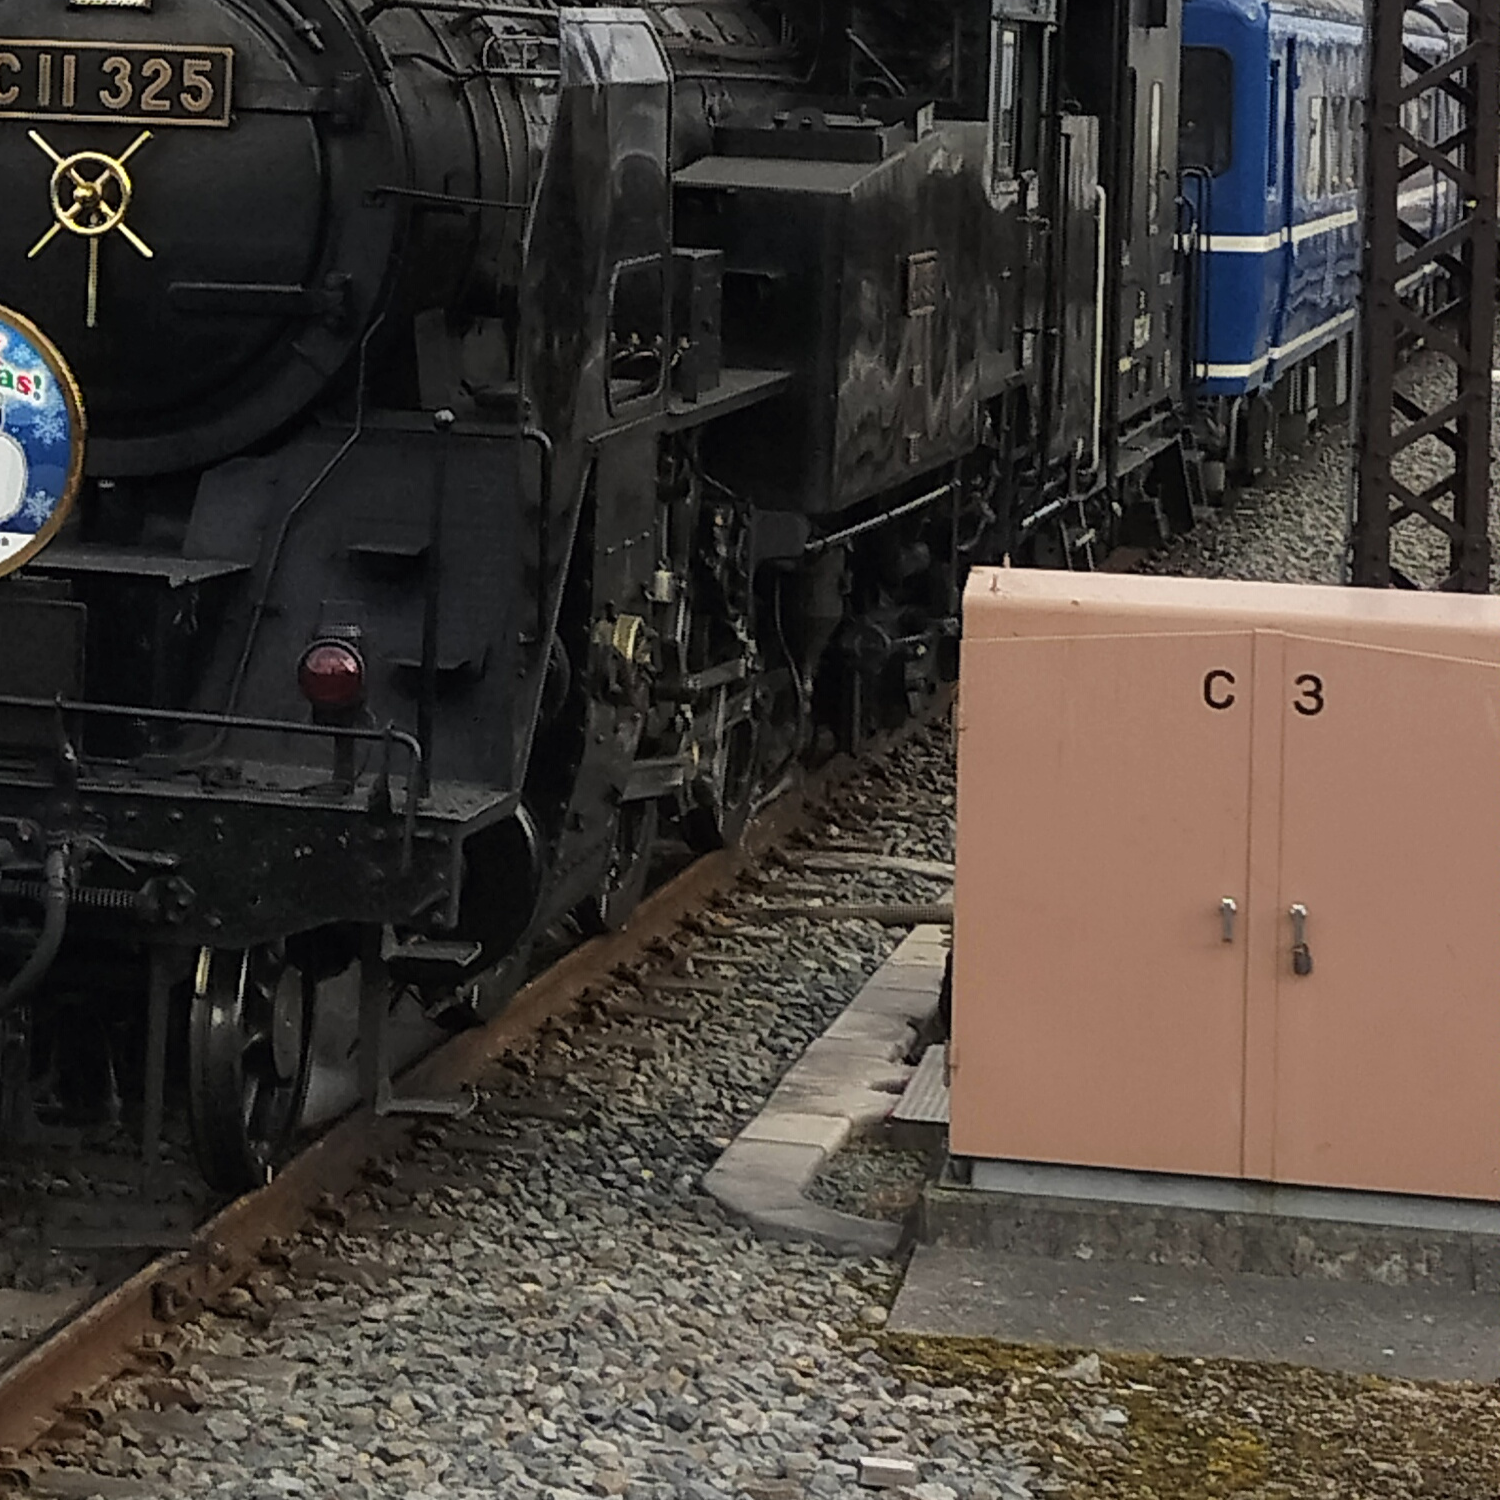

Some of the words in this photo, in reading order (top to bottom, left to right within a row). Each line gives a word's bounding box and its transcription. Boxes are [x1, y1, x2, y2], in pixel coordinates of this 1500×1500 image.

[99, 56, 214, 113] 325
[1203, 668, 1236, 711] C
[1293, 673, 1325, 716] 3
